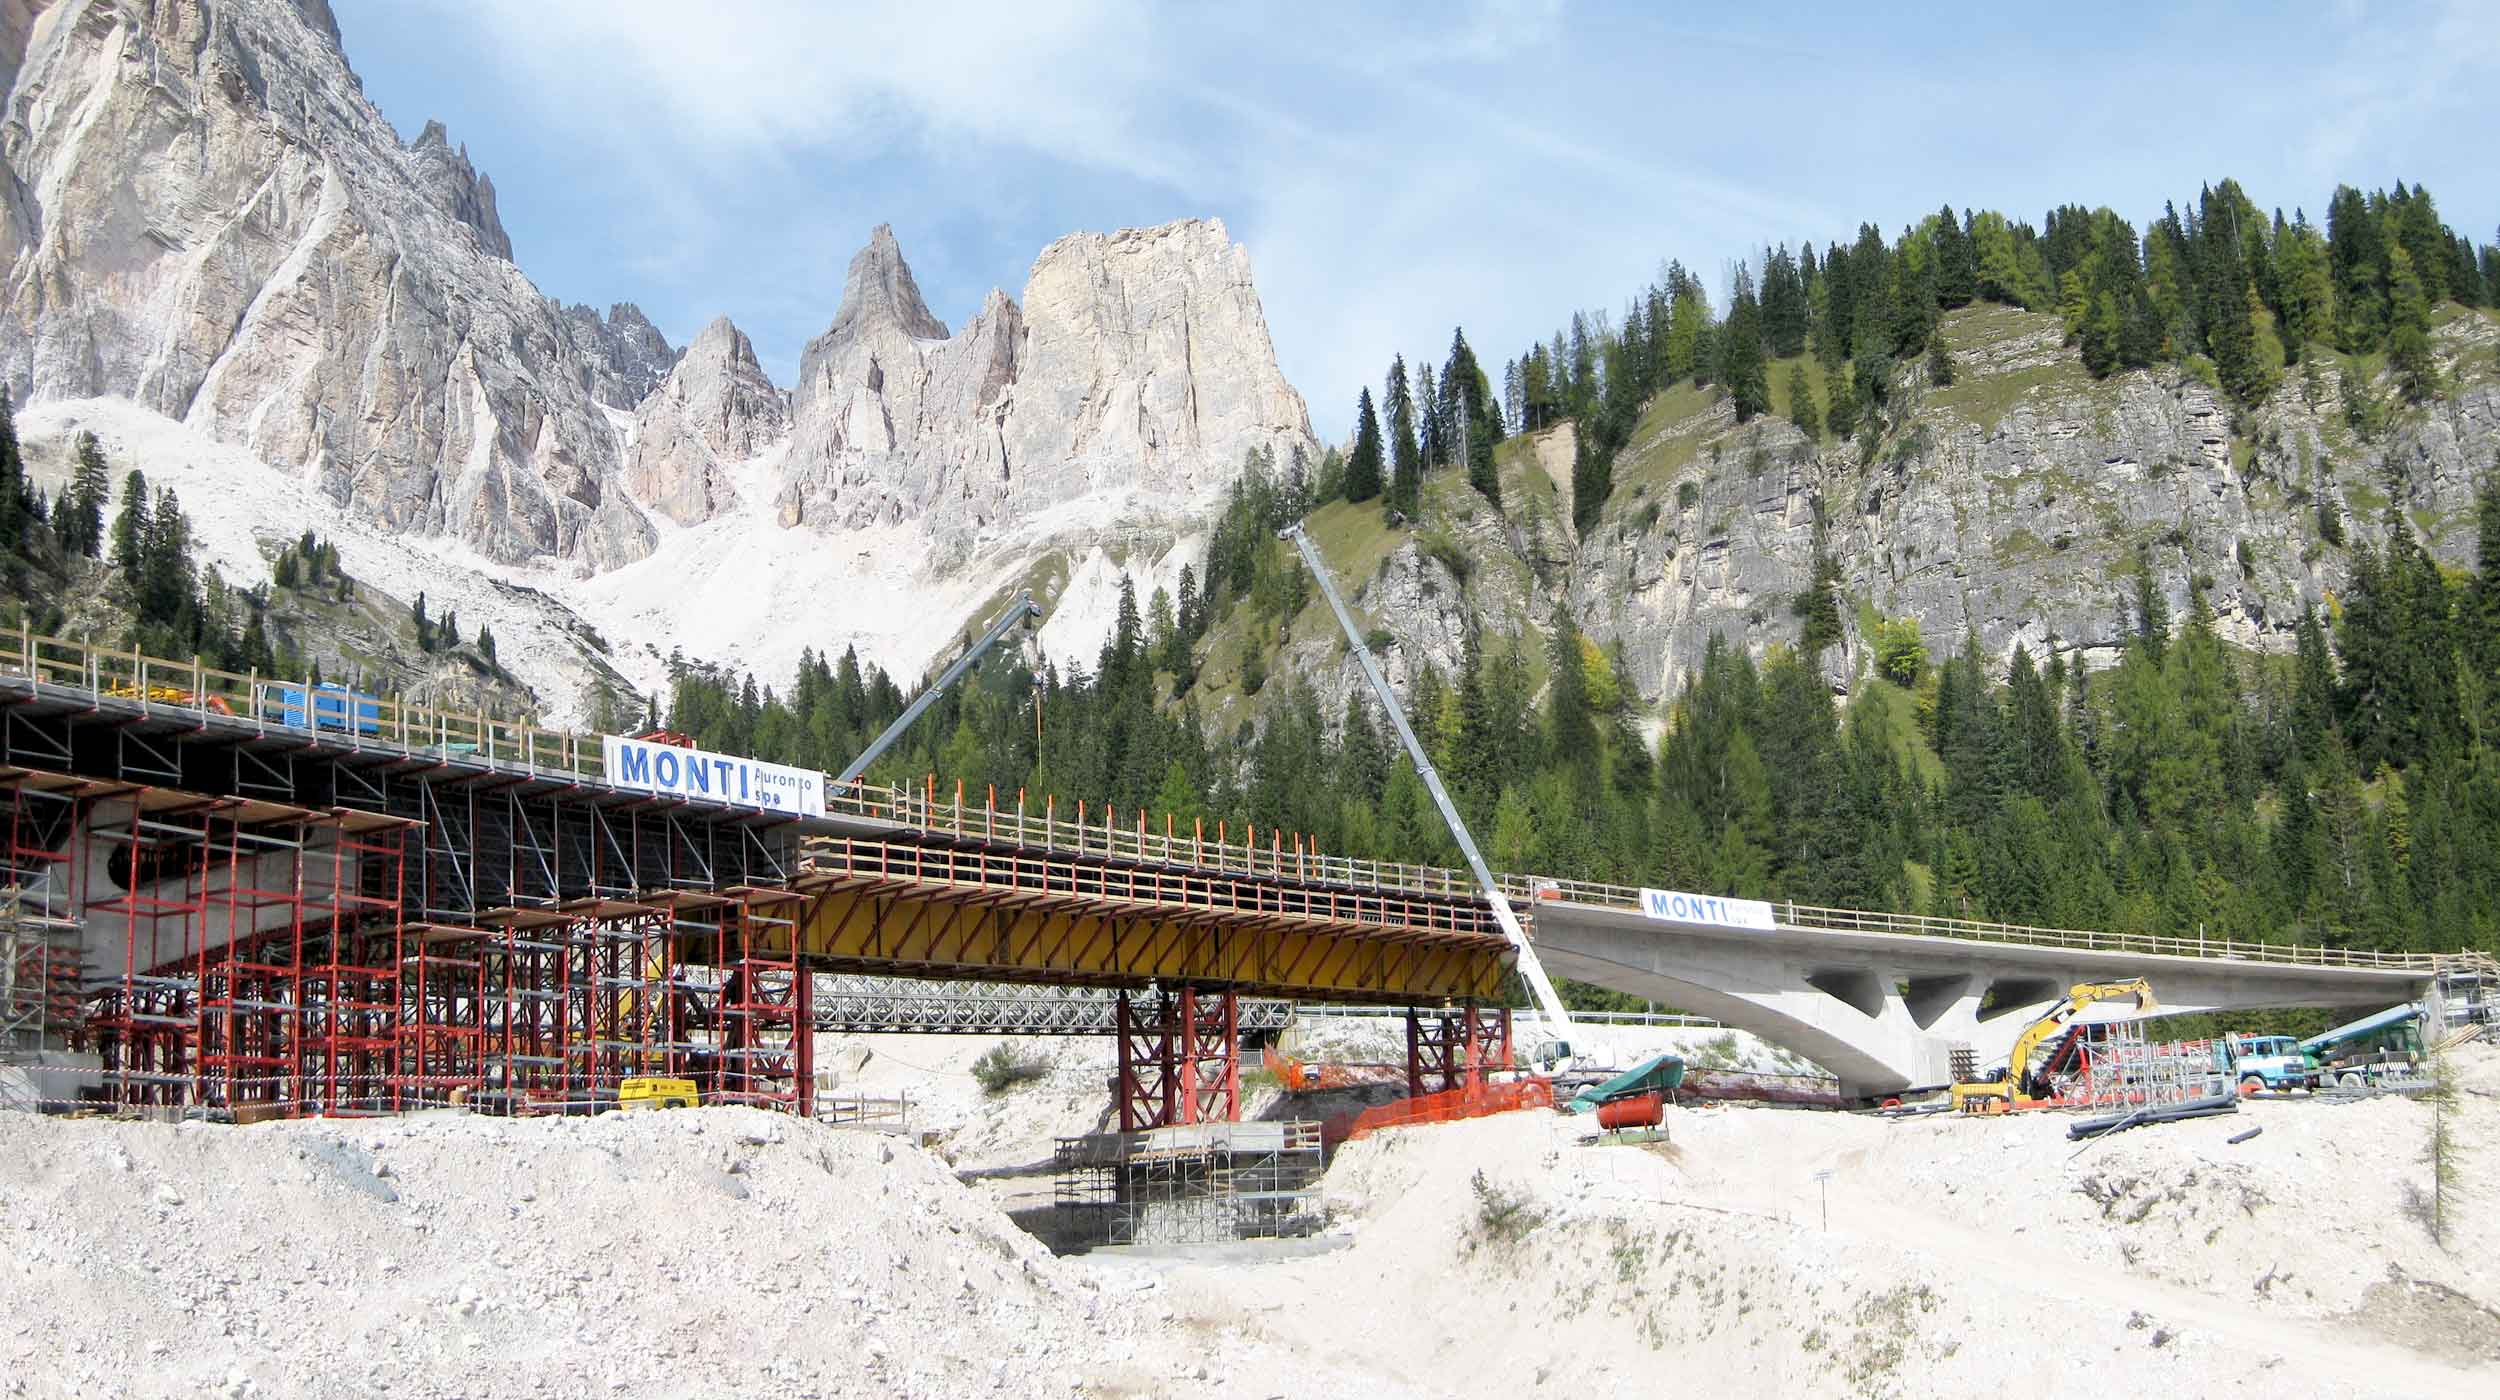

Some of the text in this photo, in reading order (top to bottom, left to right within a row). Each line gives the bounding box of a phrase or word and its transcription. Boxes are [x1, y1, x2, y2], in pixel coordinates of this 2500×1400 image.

[621, 744, 748, 799] MONTI
[755, 789, 781, 806] spa
[1651, 893, 1729, 921] MONTI
